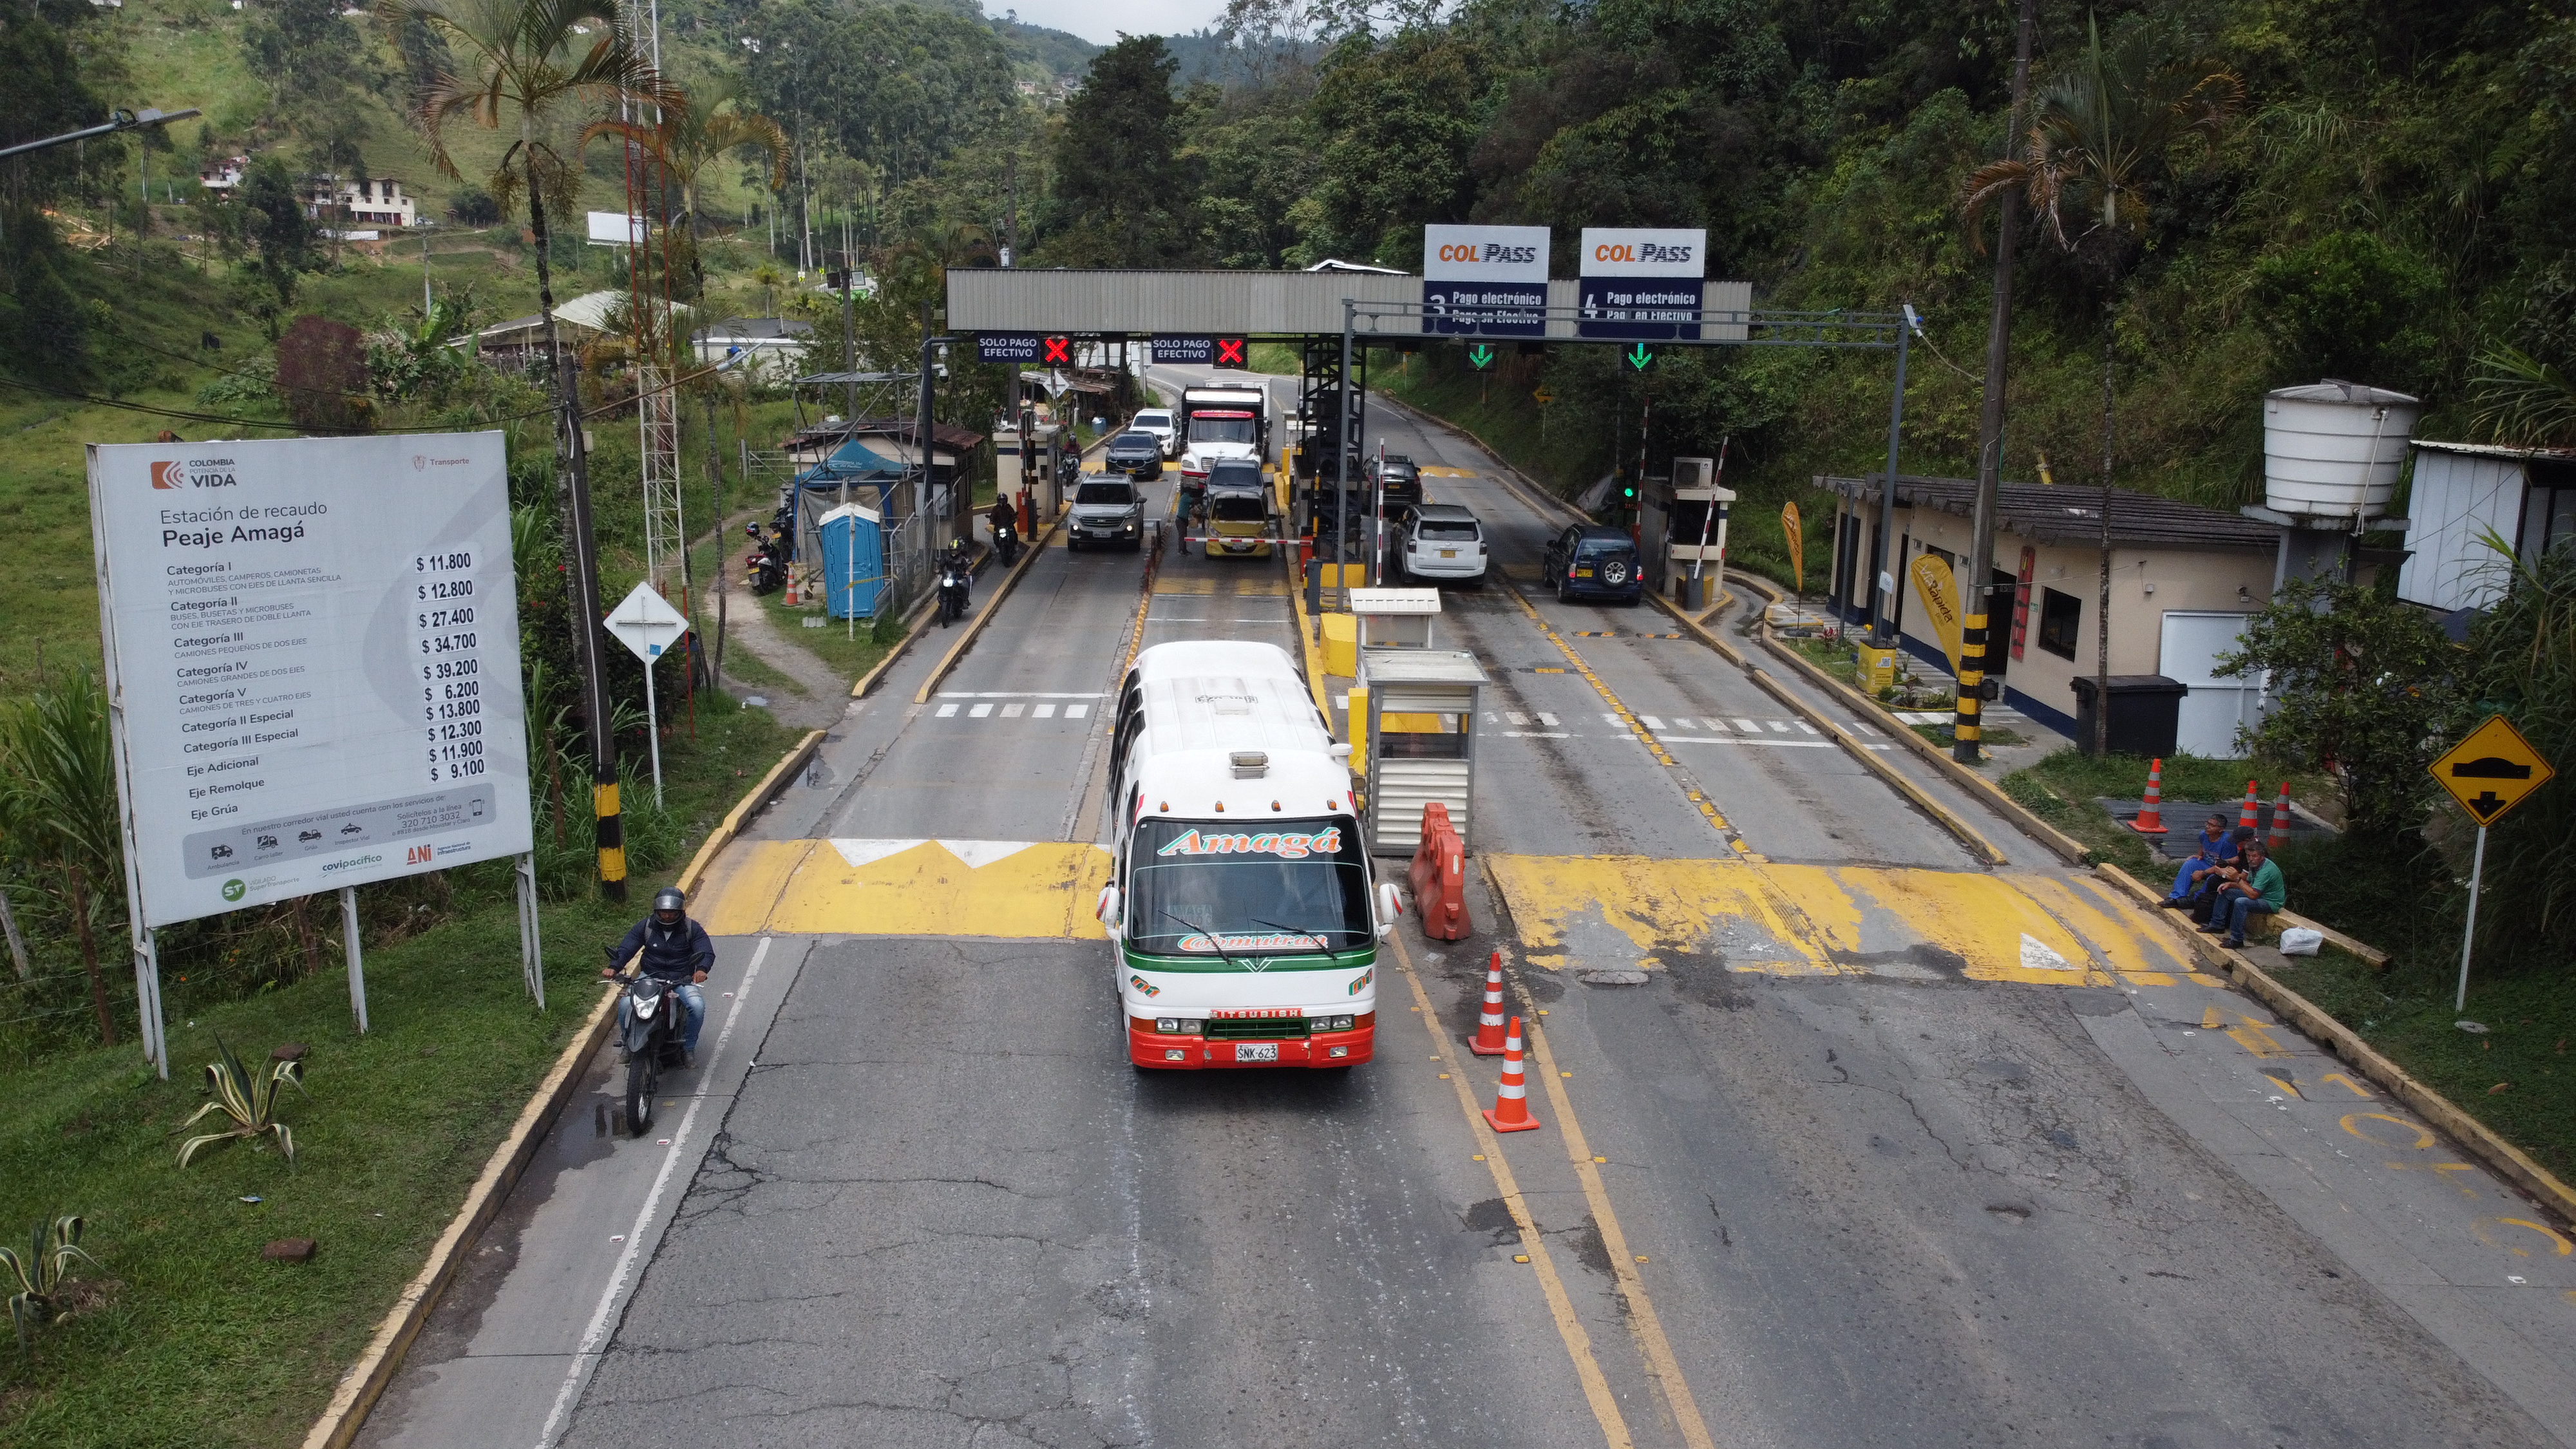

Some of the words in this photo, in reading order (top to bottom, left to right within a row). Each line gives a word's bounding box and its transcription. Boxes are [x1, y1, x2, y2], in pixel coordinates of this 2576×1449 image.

[1430, 294, 1446, 315] 3
[1453, 292, 1477, 305] Pago
[1481, 292, 1541, 305] electrónico
[1584, 294, 1598, 319] 4
[1607, 292, 1632, 306] Pago
[1636, 292, 1695, 305] electrónico
[1607, 310, 1627, 321] Pag
[1635, 311, 1647, 321] en
[980, 338, 1007, 347] SOLO
[1009, 338, 1037, 347] PAGO
[1153, 339, 1181, 348] SOLO
[1183, 339, 1211, 348] PAGO
[984, 348, 1033, 357] EFECTIVO
[1157, 350, 1206, 359] EFECTIVO
[189, 459, 235, 467] COLOMBIA
[191, 474, 236, 488] VIDA
[161, 506, 233, 524] Estación
[240, 506, 259, 520] de
[265, 502, 327, 518] recaudo
[163, 527, 223, 549] Peaje
[231, 520, 305, 542] Amagá
[167, 562, 225, 576] Categoría
[229, 562, 232, 571] I
[417, 557, 424, 572] $
[430, 553, 471, 571] 11.800
[274, 567, 321, 578] CAMIONETAS
[175, 582, 228, 595] MICROBUSES
[230, 582, 247, 591] CON
[278, 578, 306, 586] LLANTA
[307, 574, 341, 583] SENCILLA
[419, 586, 426, 601] $
[431, 580, 473, 600] 12.800
[171, 598, 227, 611] Categoría
[231, 596, 238, 606] II
[201, 609, 237, 618] BUSETAS
[245, 603, 294, 614] MICROBUSES
[206, 617, 243, 627] TRASERO
[257, 614, 281, 622] DOBLE
[283, 611, 311, 619] LLANTA
[420, 614, 427, 629] $
[432, 607, 474, 627] 27.400
[174, 633, 230, 648] Categoría
[234, 632, 243, 641] III
[422, 639, 430, 654] $
[435, 632, 477, 653] 34.700
[175, 648, 216, 659] CAMIONES
[177, 663, 232, 677] Categoría
[236, 661, 248, 671] IV
[424, 666, 431, 681] $
[436, 659, 478, 679] 39.200
[177, 676, 218, 687] CAMIONES
[221, 672, 258, 682] GRANDES
[179, 690, 234, 705] Categoría
[237, 688, 247, 697] V
[425, 687, 432, 702] $
[446, 681, 479, 699] 6.200
[180, 703, 221, 714] CAMIONES
[262, 694, 294, 704] CUATRO
[426, 706, 433, 721] $
[439, 699, 480, 719] 13.800
[182, 717, 236, 733] Categoría
[240, 715, 246, 725] II
[250, 709, 294, 723] Especial
[184, 737, 238, 753] Categoría
[242, 735, 251, 745] III
[255, 728, 298, 743] Especial
[428, 728, 435, 743] $
[441, 720, 482, 741] 12.300
[429, 749, 437, 763] $
[442, 740, 483, 761] 11.900
[187, 766, 204, 777] Eje
[207, 757, 259, 773] Adicional
[431, 768, 439, 782] $
[451, 759, 484, 779] 9.100
[189, 788, 206, 799] Eje
[209, 780, 265, 795] Remolque
[191, 810, 208, 820] Eje
[211, 804, 238, 816] Grúa
[253, 823, 281, 833] nuestro
[283, 816, 314, 827] corredor
[330, 810, 350, 819] usted
[352, 806, 377, 815] cuenta
[404, 797, 434, 807] servicios
[402, 819, 418, 828] 320
[421, 816, 437, 824] 710
[440, 811, 460, 821] 3032
[1157, 827, 1342, 858] Amagá
